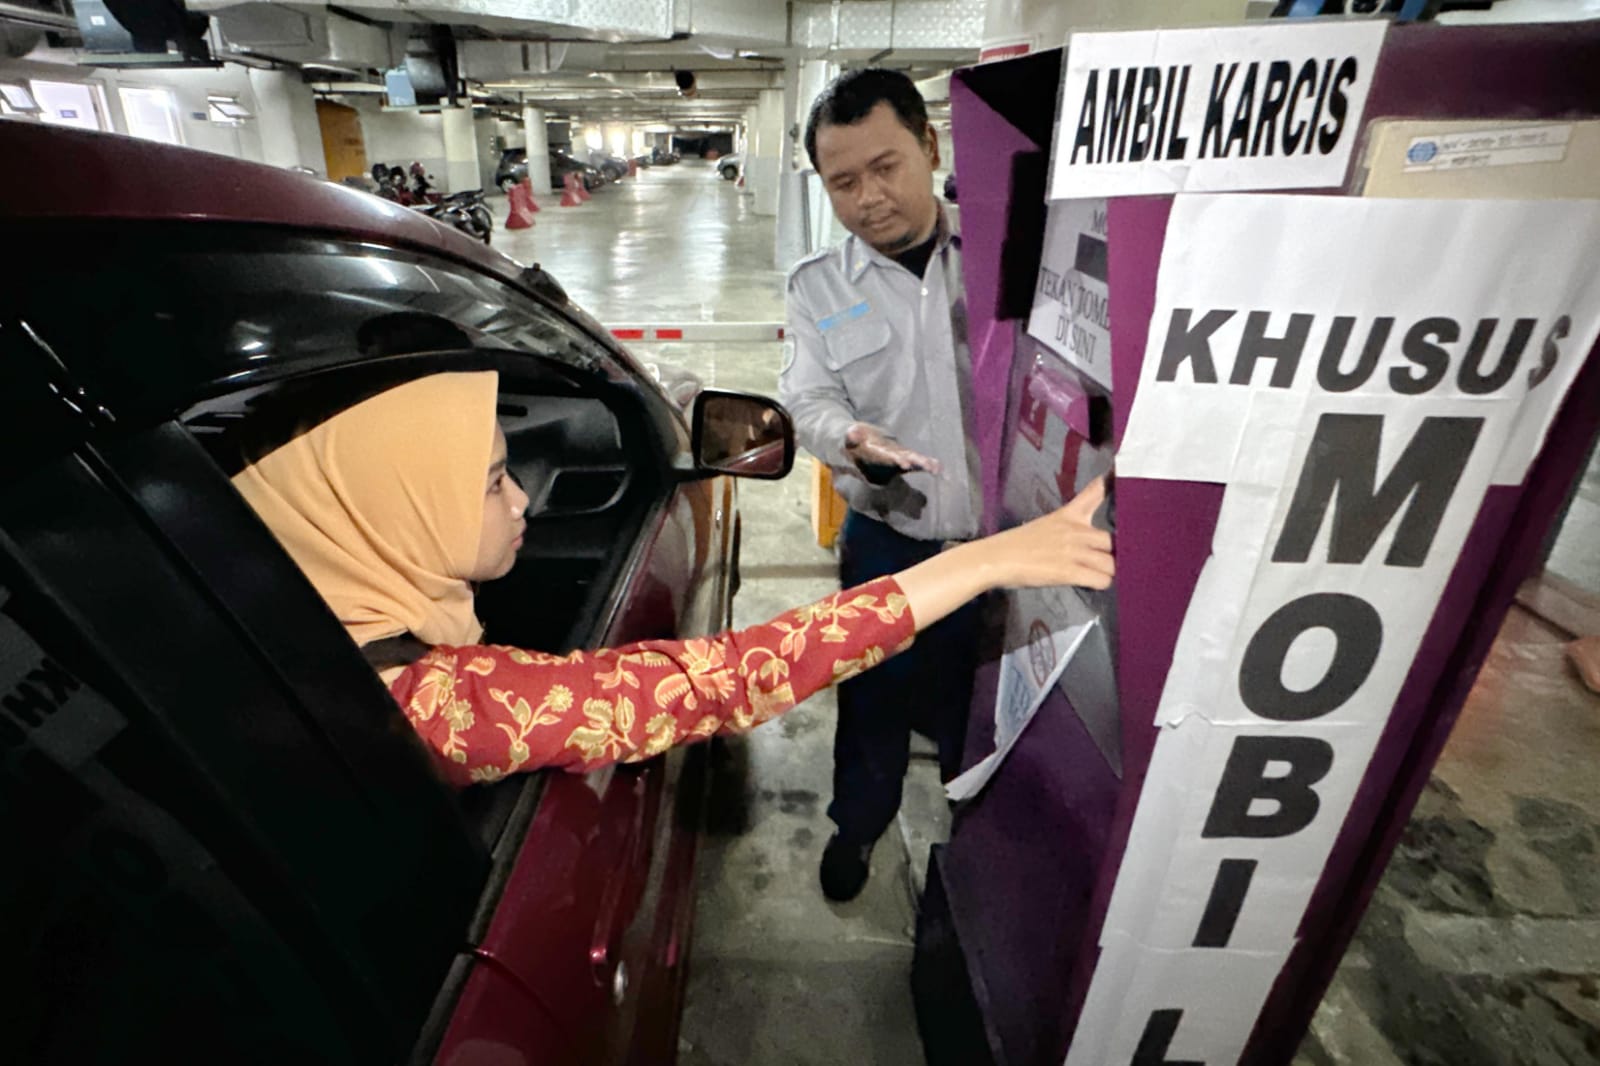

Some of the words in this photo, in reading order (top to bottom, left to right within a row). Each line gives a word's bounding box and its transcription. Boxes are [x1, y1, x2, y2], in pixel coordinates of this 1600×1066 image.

[1069, 64, 1192, 165] AMBIL
[1197, 56, 1357, 159] KARCIS
[1056, 315, 1070, 347] DI
[1070, 325, 1097, 364] SINI
[1155, 308, 1571, 395] KHUSUS
